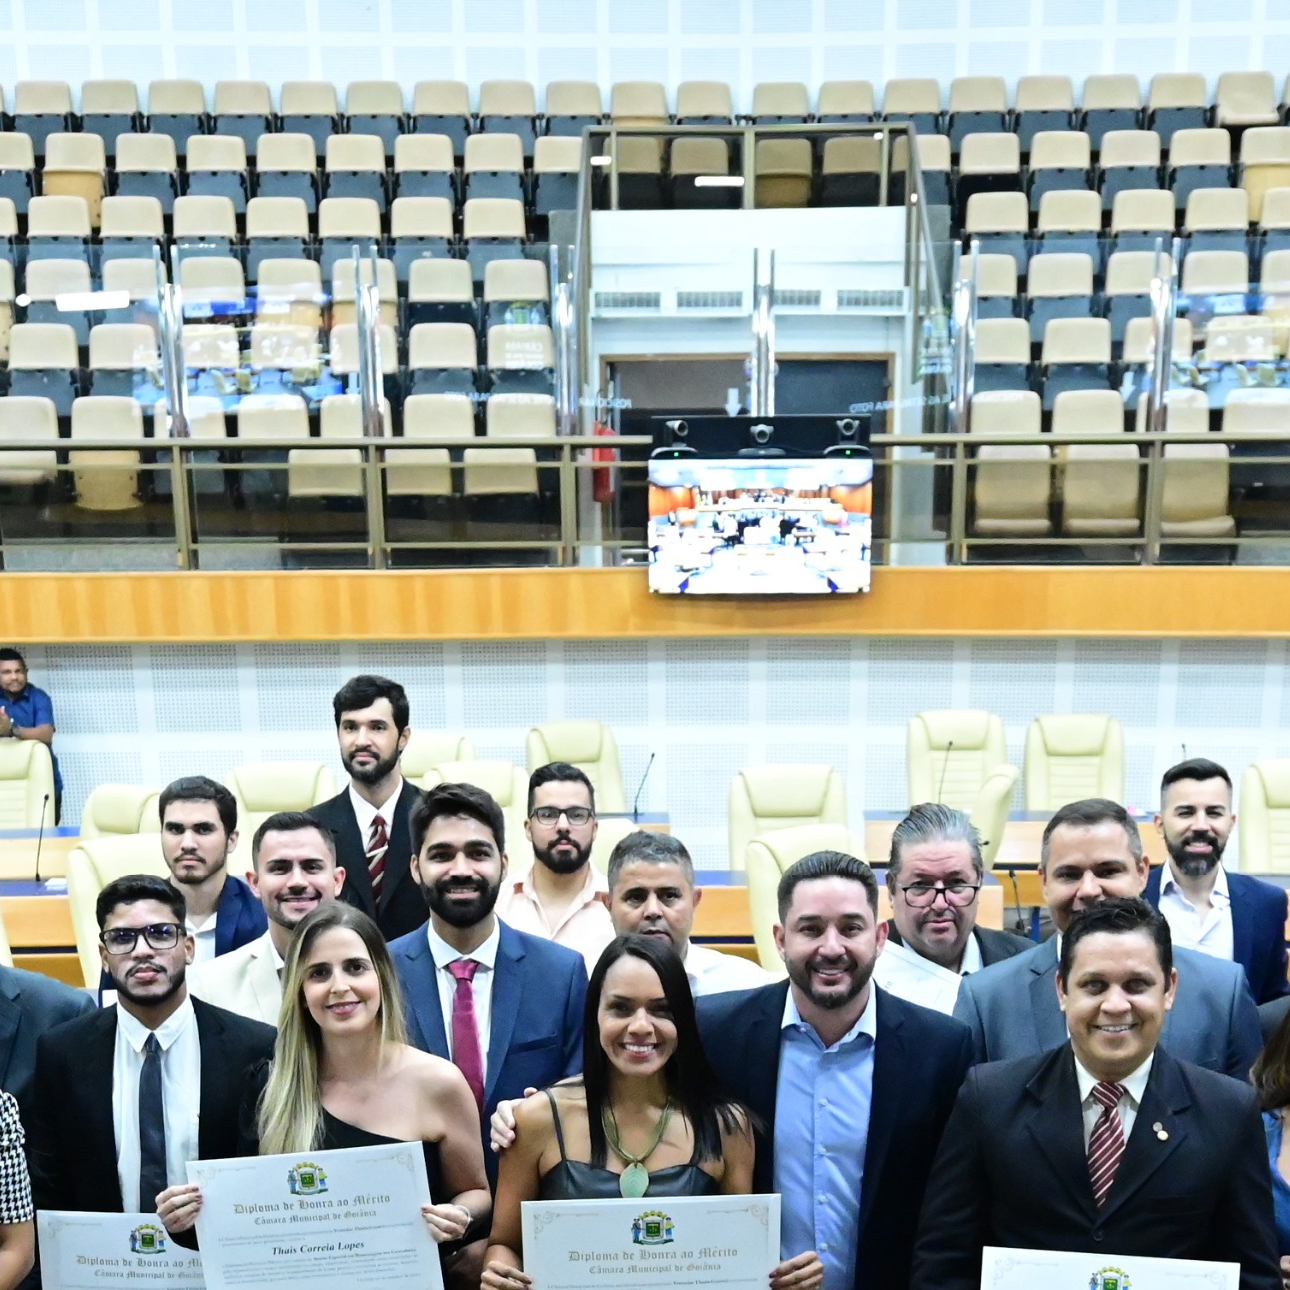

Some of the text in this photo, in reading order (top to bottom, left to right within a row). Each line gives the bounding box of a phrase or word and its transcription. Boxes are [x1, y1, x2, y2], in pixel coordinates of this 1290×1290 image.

[233, 1193, 390, 1215] Diploma de Honra ao Mérito
[253, 1208, 376, 1226] Câmara Municipal de Goiânia
[299, 1243, 335, 1253] Correia
[337, 1241, 364, 1251] Lopes
[568, 1245, 738, 1263] Diploma de Honra ao Mérito
[76, 1254, 119, 1266] Diploma
[121, 1257, 132, 1267] de
[136, 1257, 169, 1268] Honra
[172, 1260, 183, 1268] ao
[588, 1261, 721, 1274] Câmara Municipal de Goiânia
